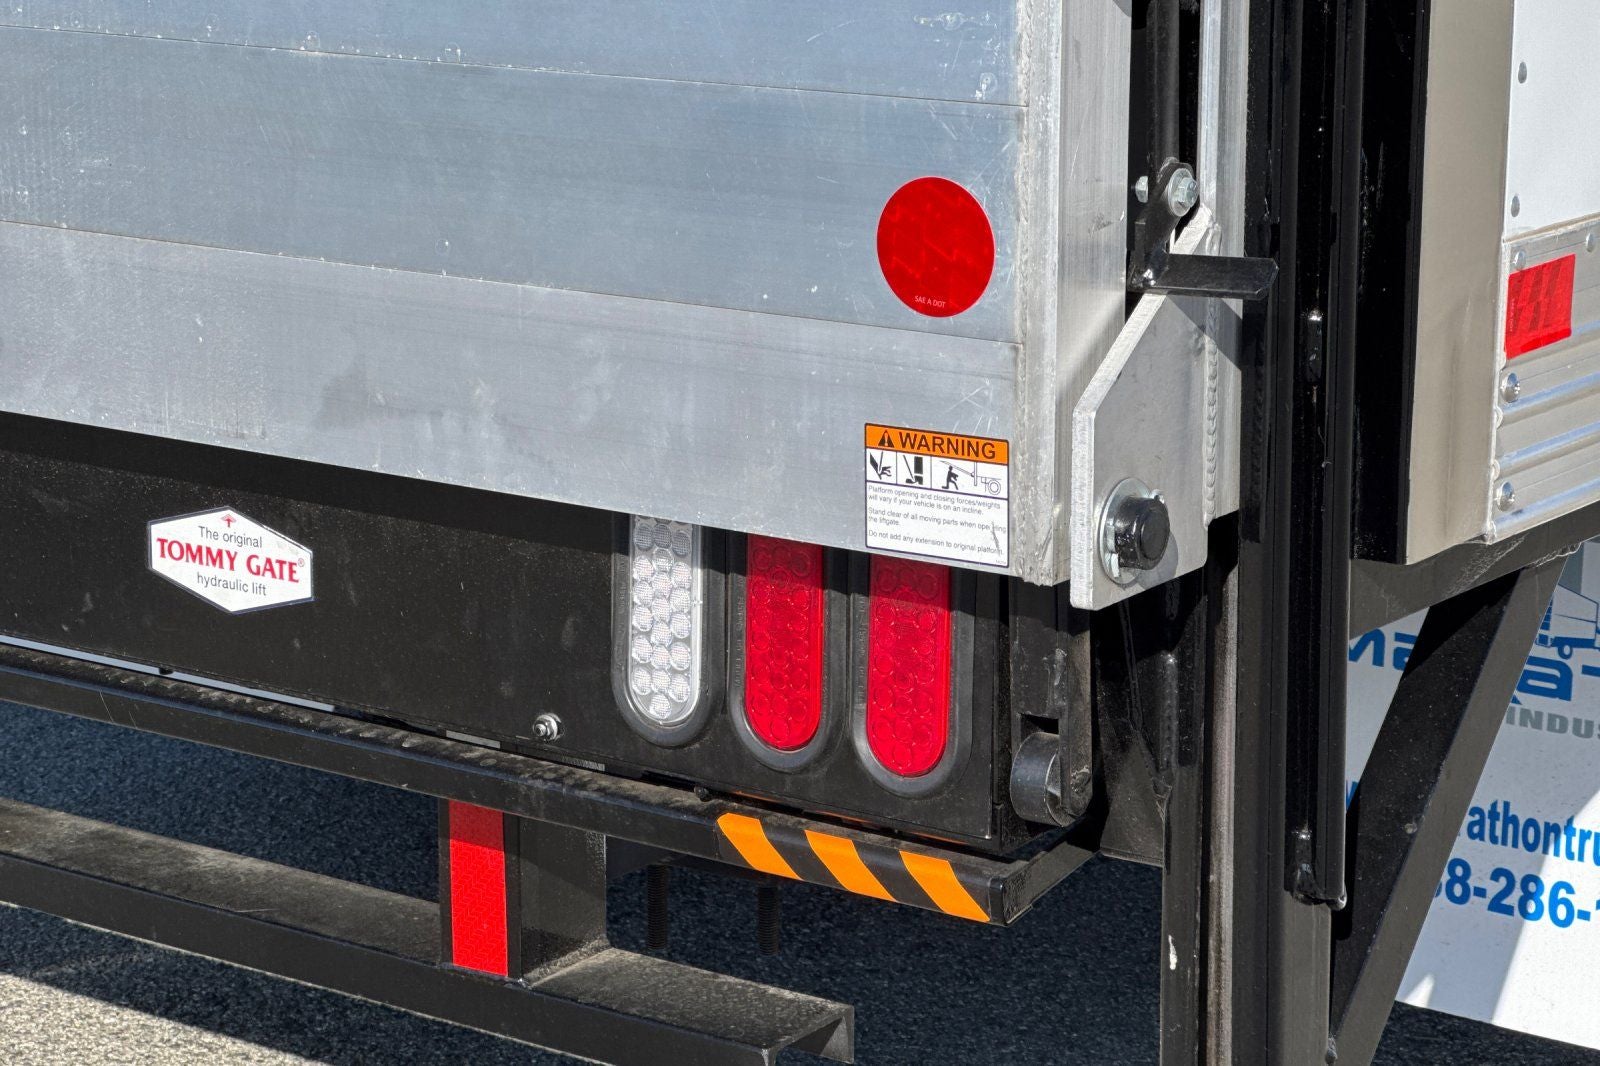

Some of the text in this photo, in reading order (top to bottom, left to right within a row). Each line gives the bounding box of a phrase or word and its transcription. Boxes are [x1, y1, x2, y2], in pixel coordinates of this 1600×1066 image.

[915, 295, 946, 308] SAE A DOT
[899, 431, 996, 460] WARNING
[868, 485, 894, 494] Platform
[894, 490, 919, 499] opening
[933, 494, 955, 504] closing
[879, 496, 892, 504] vary
[913, 500, 935, 508] vehicle
[868, 515, 878, 523] the
[868, 507, 886, 515] Stand
[919, 515, 941, 525] moving
[942, 518, 959, 526] parts
[959, 520, 977, 528] when
[977, 523, 1007, 534] operting
[198, 525, 263, 548] The original
[868, 529, 878, 537] Do
[889, 533, 902, 541] add
[902, 536, 914, 544] any
[915, 537, 945, 547] extension
[953, 543, 977, 552] original
[156, 537, 238, 571] TOMMY
[197, 572, 267, 596] hydraulic lift
[1505, 706, 1600, 741] INDU
[1435, 857, 1600, 928] 8-286-
